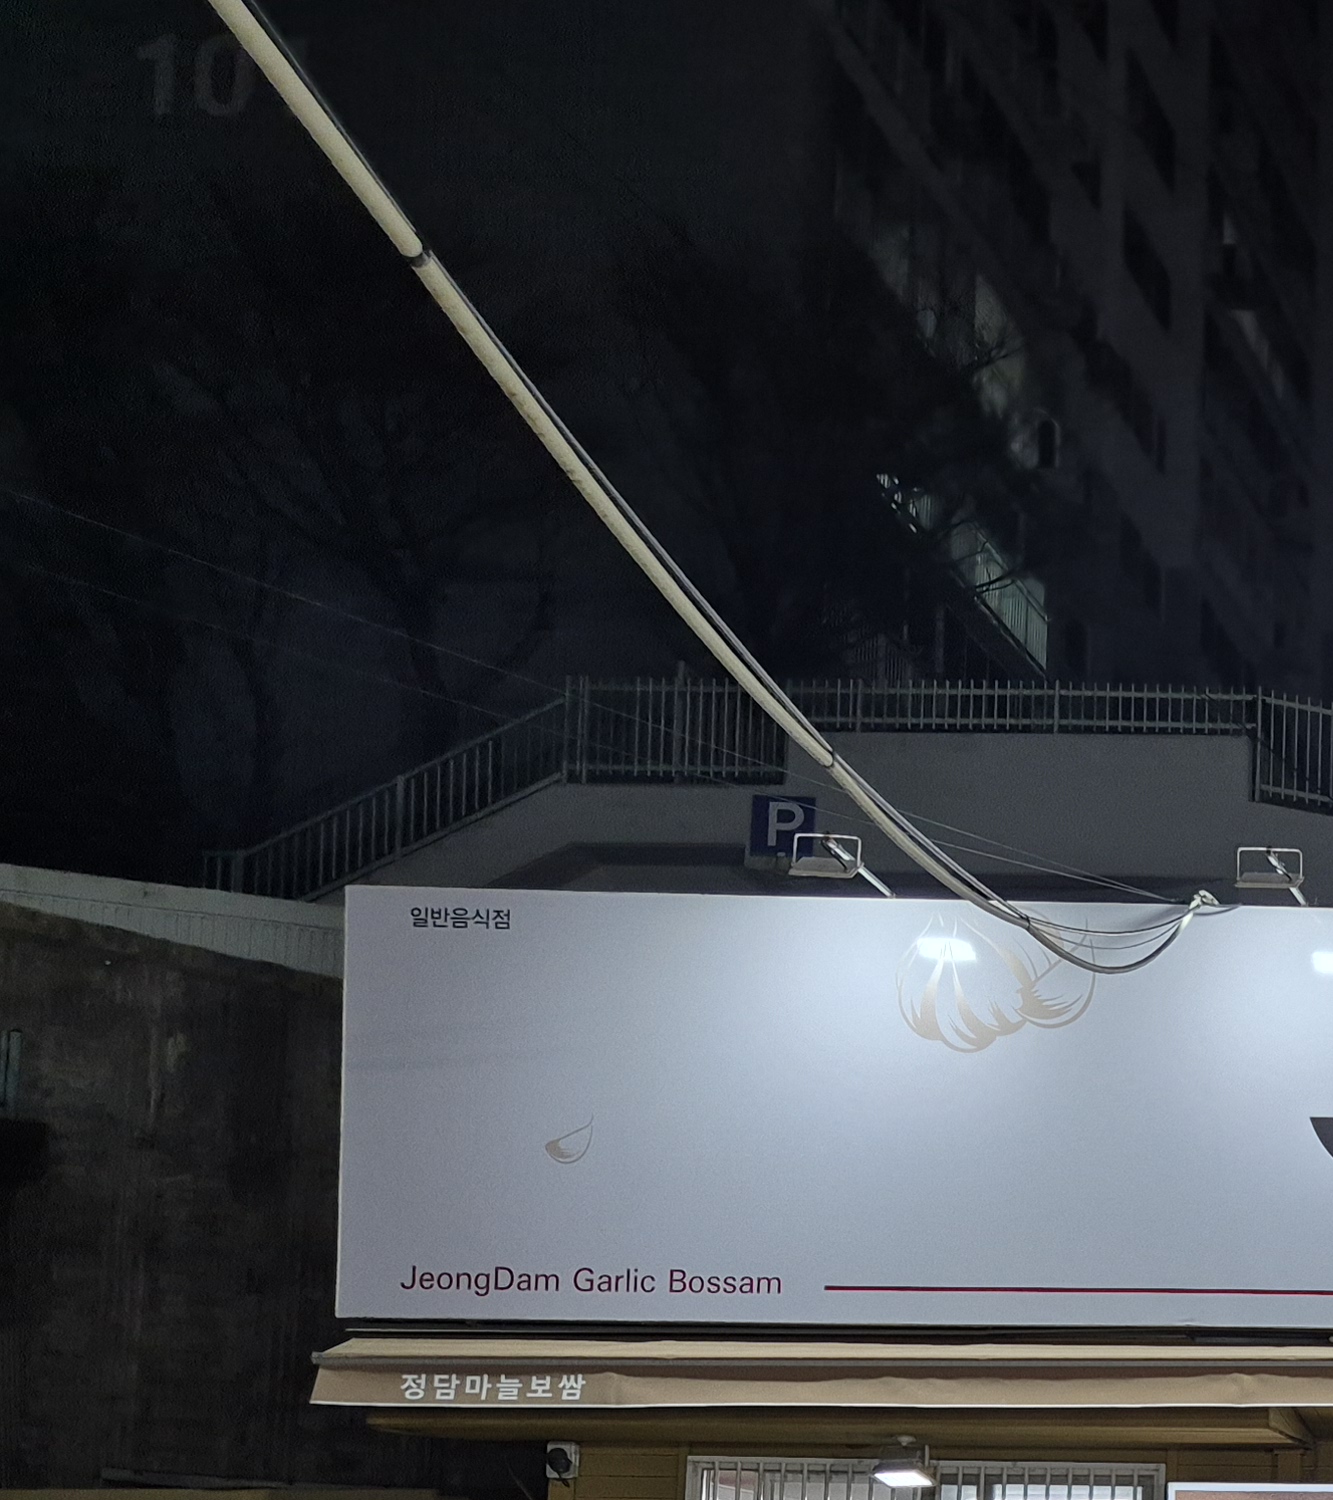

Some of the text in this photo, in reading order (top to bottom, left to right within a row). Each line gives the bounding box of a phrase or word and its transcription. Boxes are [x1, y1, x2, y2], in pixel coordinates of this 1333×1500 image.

[136, 32, 308, 118] 10
[767, 801, 805, 847] P
[409, 906, 512, 931] 일반음식점
[400, 1264, 783, 1296] JeongDam Garlic Bossam
[399, 1371, 587, 1401] 정담마늘보쌈
